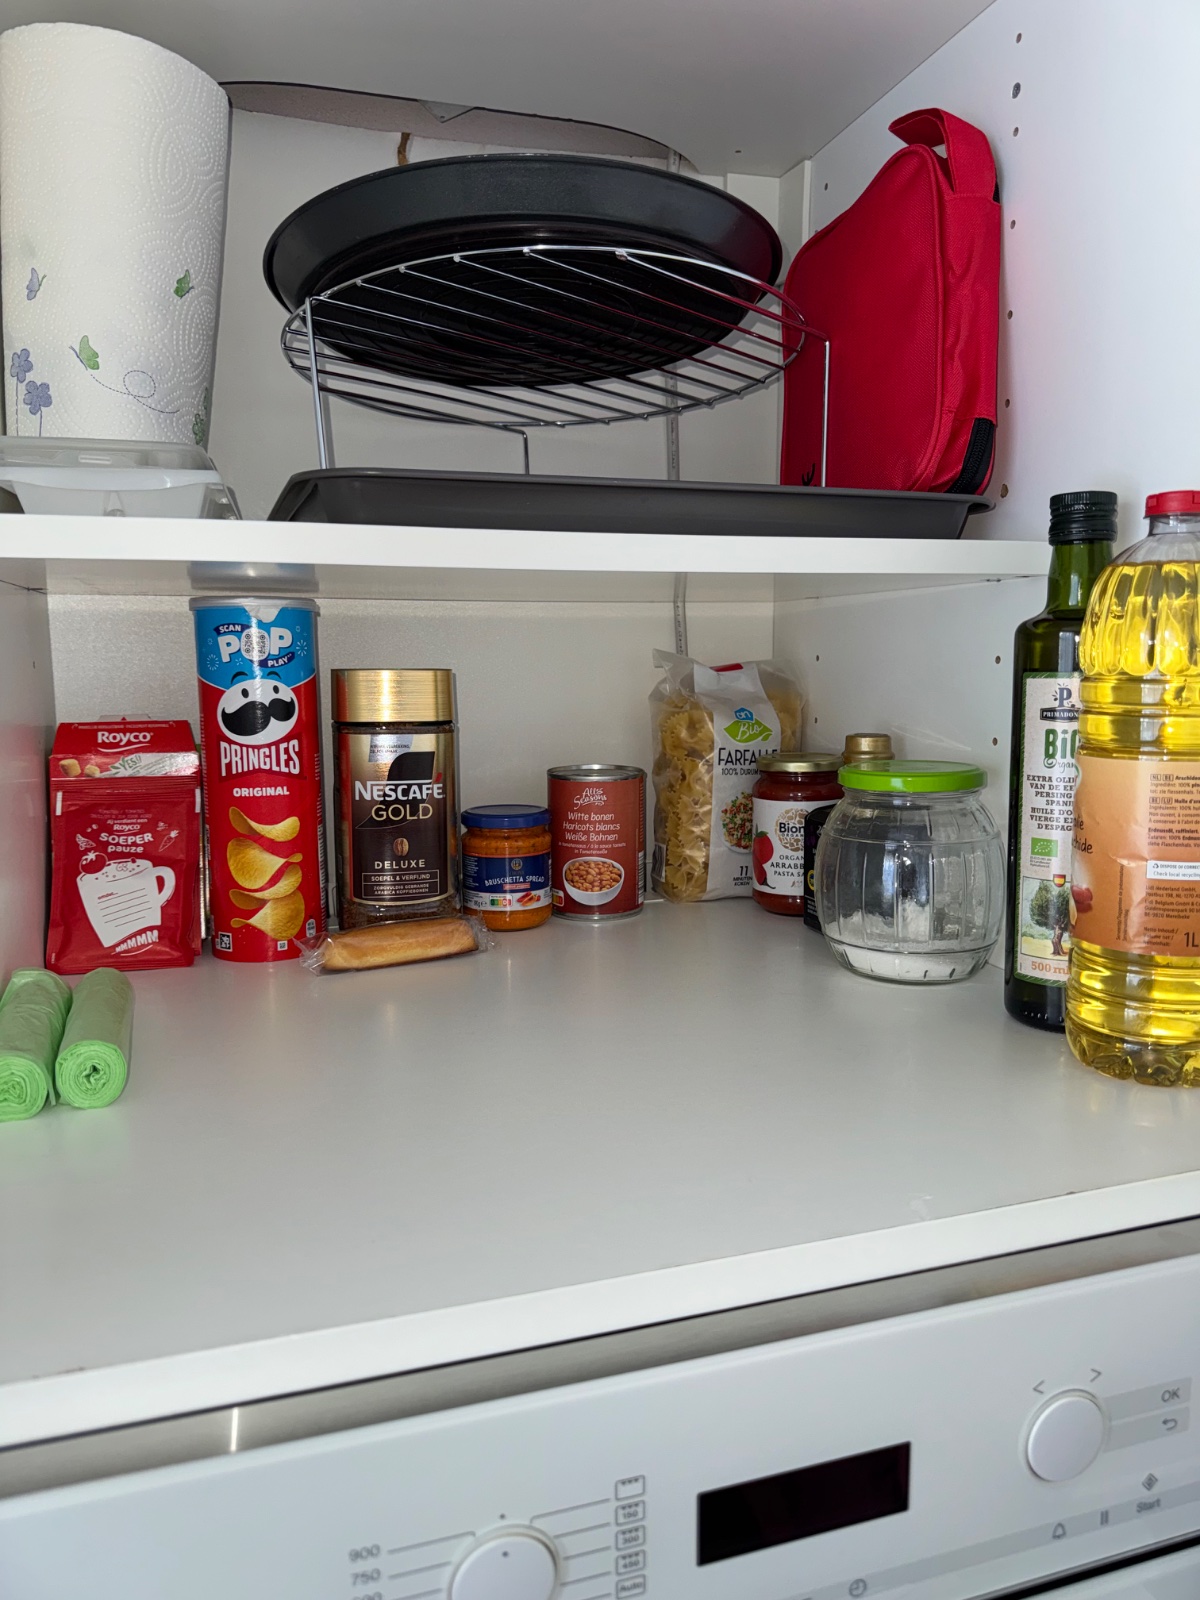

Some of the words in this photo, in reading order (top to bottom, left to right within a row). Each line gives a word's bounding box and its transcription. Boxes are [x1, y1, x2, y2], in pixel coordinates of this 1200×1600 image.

[218, 624, 242, 634] SCAN
[217, 627, 293, 663] POP
[736, 722, 763, 740] Bio
[97, 731, 151, 746] Royco
[220, 739, 300, 777] PRINGLES
[721, 768, 739, 776] 100%
[1026, 774, 1053, 783] EXTRA
[233, 786, 290, 797] ORIGINAL
[1034, 791, 1073, 799] PERSING
[371, 803, 433, 821] GOLD
[568, 811, 589, 821] Witte
[590, 812, 615, 821] bonen
[1030, 806, 1055, 815] HUILE
[1029, 814, 1061, 823] VIERGE
[113, 824, 141, 832] Royco
[563, 821, 594, 831] Haricots
[595, 823, 621, 831] blancs
[99, 832, 154, 845] SOEPER
[565, 832, 588, 841] Weiße
[589, 832, 619, 842] Bohnen
[107, 845, 144, 853] pauze
[374, 859, 426, 870] DELUXE
[401, 873, 431, 881] VERFIJND
[739, 866, 749, 877] 11
[484, 875, 524, 887] BRUSCHETTA
[525, 875, 545, 883] SPREAD
[1183, 931, 1199, 948] 1L
[1031, 961, 1052, 973] 500
[1160, 1387, 1181, 1403] OK
[1136, 1498, 1161, 1514] Start
[622, 1534, 640, 1546] 300
[349, 1544, 381, 1562] 900
[351, 1568, 381, 1587] 750
[618, 1580, 644, 1594] Auto
